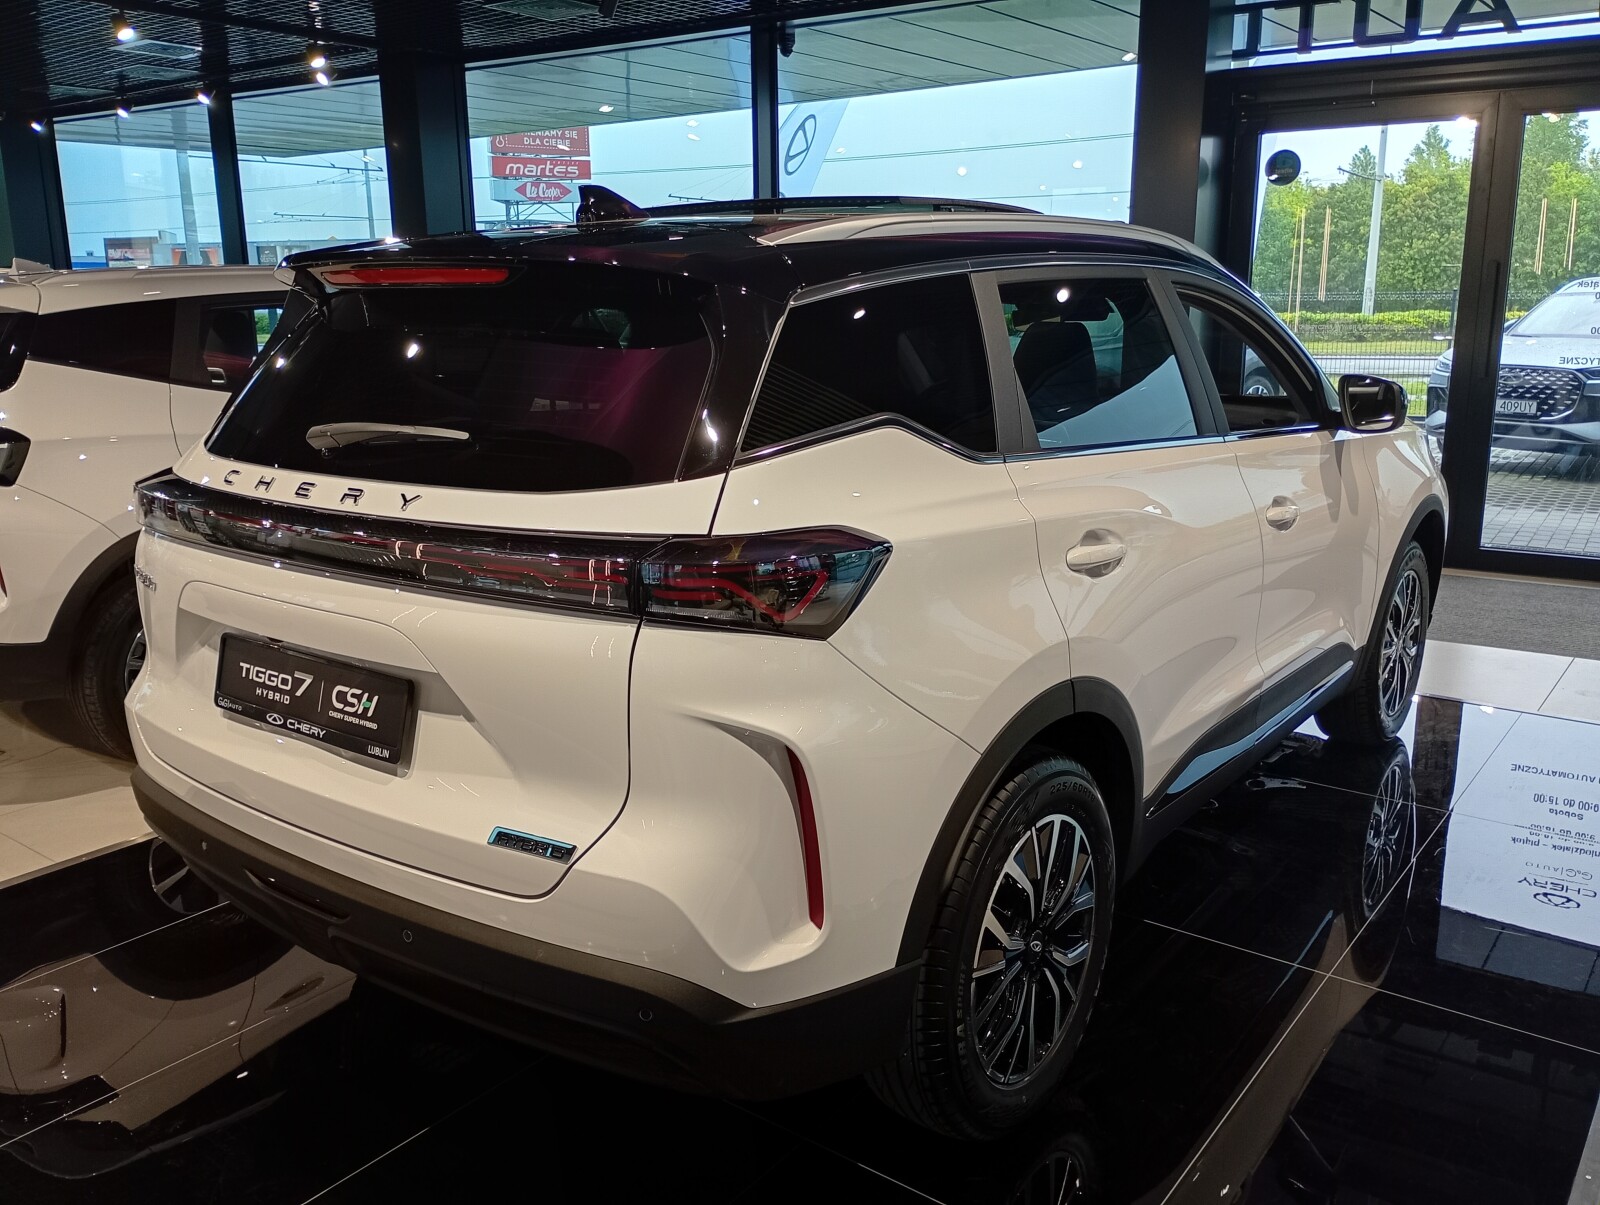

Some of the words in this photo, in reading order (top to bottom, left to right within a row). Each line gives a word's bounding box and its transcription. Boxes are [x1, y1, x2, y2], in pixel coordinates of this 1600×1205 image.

[523, 137, 541, 146] DLA
[543, 138, 571, 147] CIEBIE
[565, 130, 578, 139] SIĘ
[505, 160, 579, 177] martes
[526, 182, 538, 198] Lee
[538, 182, 564, 201] Cooper
[1500, 401, 1534, 413] 409UY
[223, 469, 422, 511] CHERY
[256, 687, 290, 705] HYBRID
[331, 684, 379, 718] CSH
[328, 710, 344, 720] CHERY
[344, 714, 359, 725] SUPER
[359, 719, 378, 730] HYBRID
[286, 719, 326, 739] CHERY
[367, 745, 390, 759] LUBLIN
[1510, 763, 1596, 783] AUTOMATYCZNE
[1533, 792, 1559, 806] 15:00
[1563, 798, 1576, 808] do
[1548, 807, 1584, 821] Sobota
[1525, 861, 1560, 872] AUTO
[1517, 876, 1597, 898] CHERY
